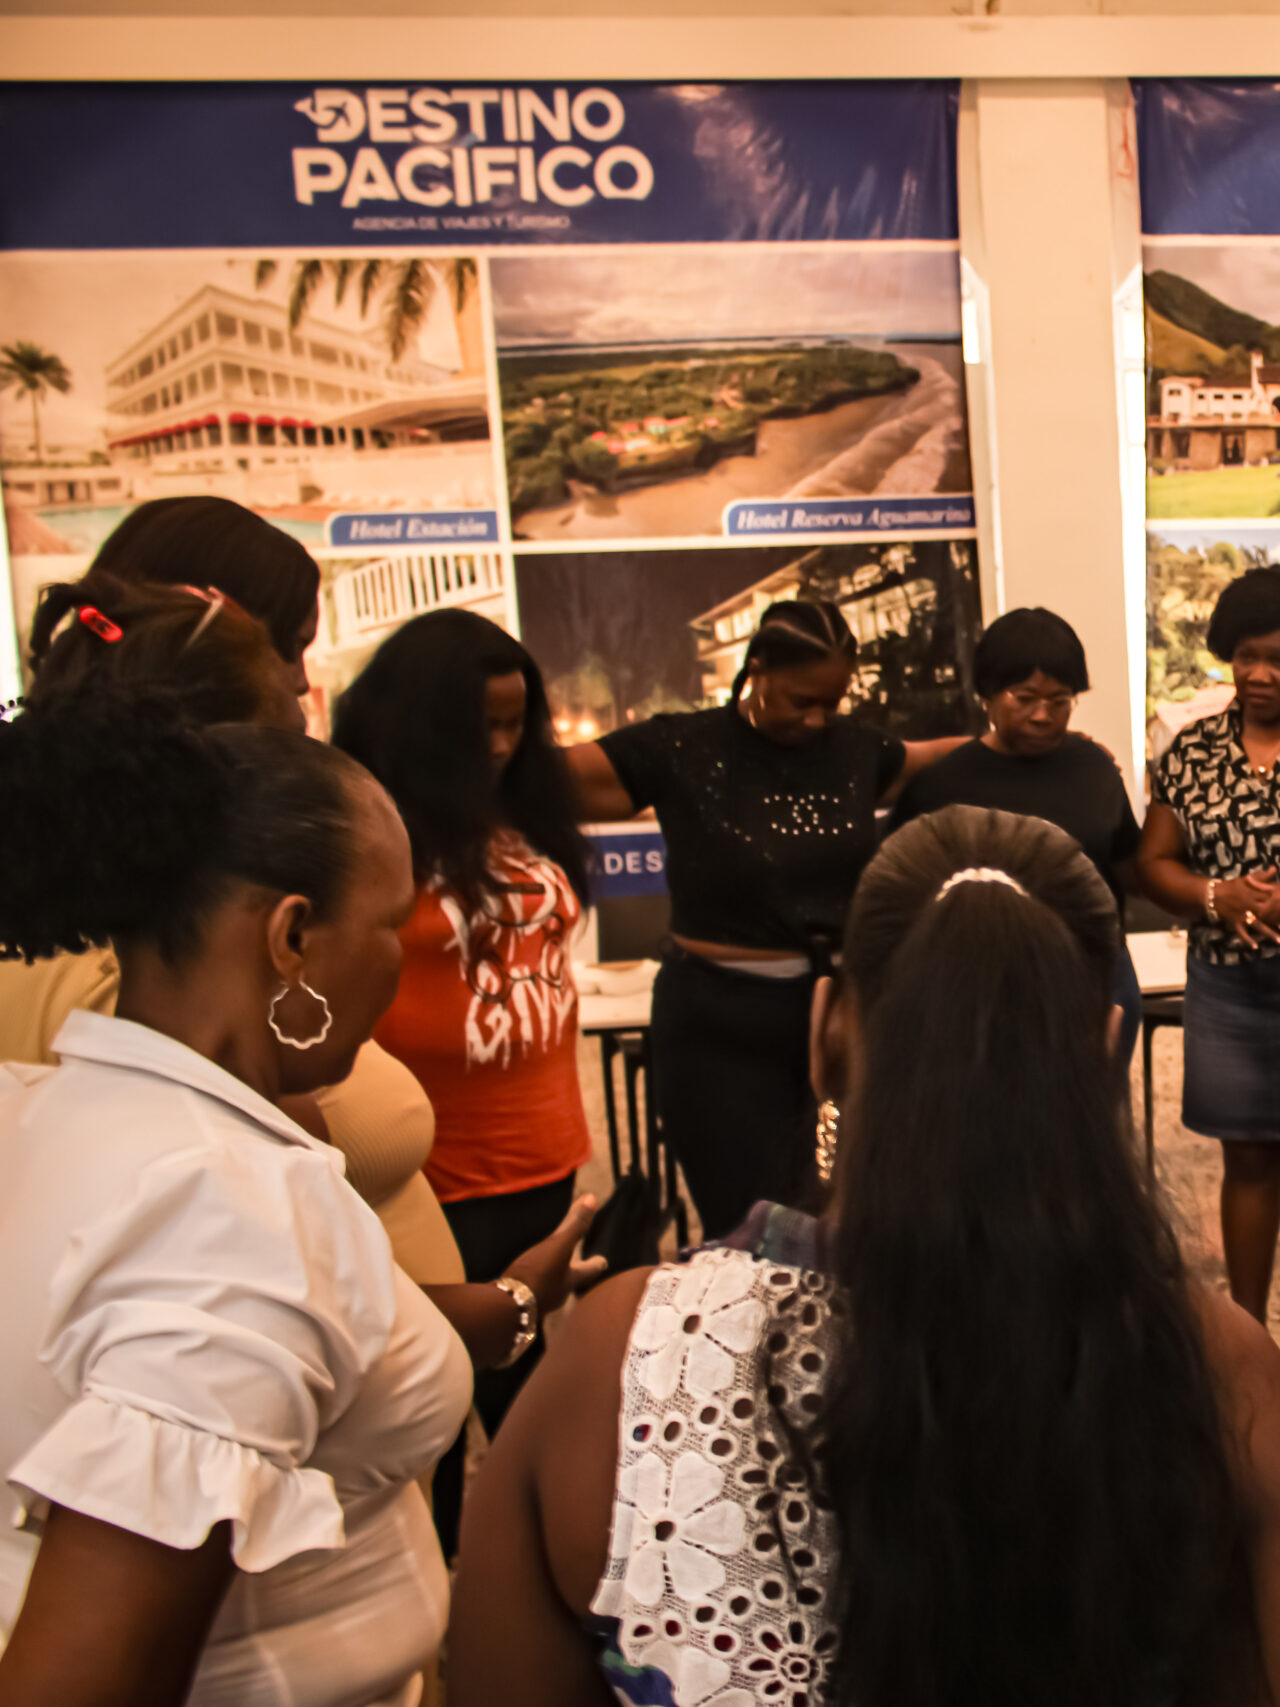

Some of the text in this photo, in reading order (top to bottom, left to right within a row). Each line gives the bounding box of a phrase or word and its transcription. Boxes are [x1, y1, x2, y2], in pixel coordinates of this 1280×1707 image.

[294, 87, 626, 142] DESTINO
[350, 517, 489, 540] Hotel Estación
[737, 509, 788, 529] Hotel
[791, 508, 863, 528] Reserva
